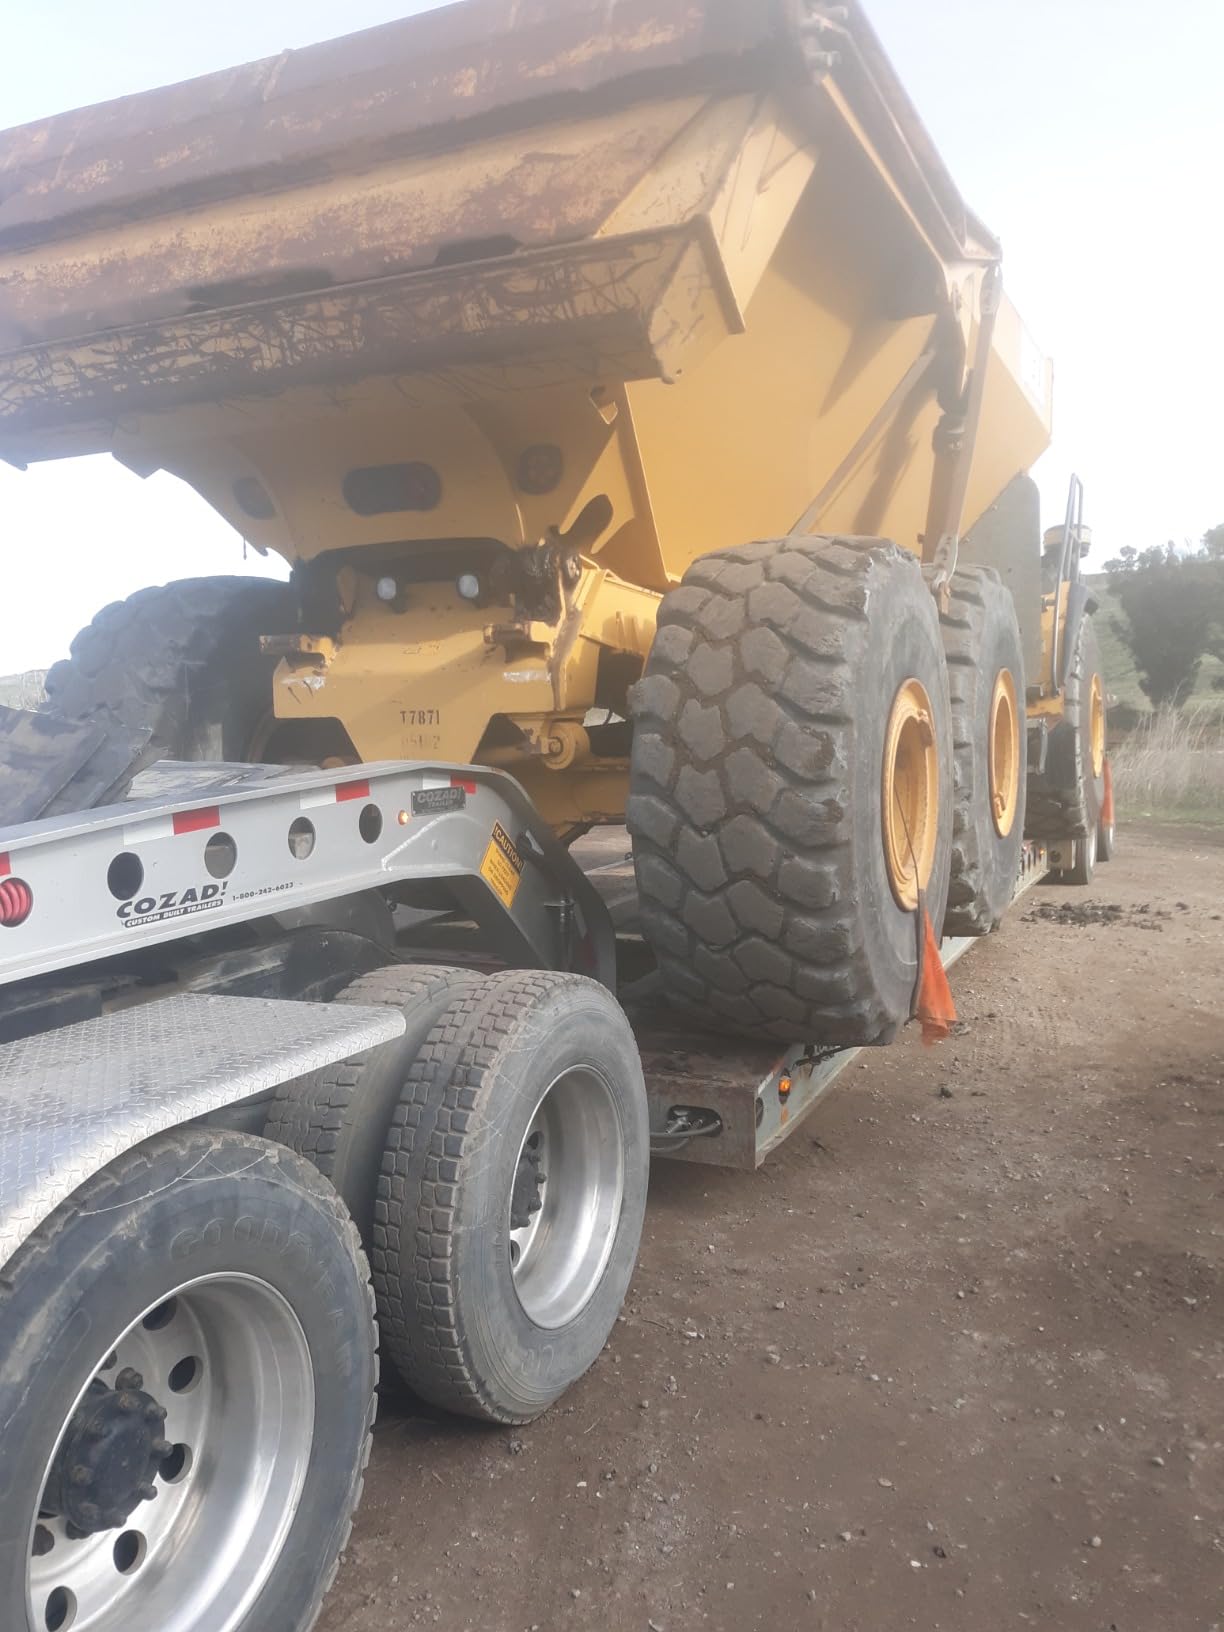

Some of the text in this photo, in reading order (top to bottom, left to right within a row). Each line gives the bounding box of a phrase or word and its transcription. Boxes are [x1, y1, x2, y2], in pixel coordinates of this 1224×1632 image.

[400, 709, 440, 725] T7871
[116, 881, 229, 918] COZAD!
[126, 900, 222, 927] CUSTOM BUILT TRAILERS
